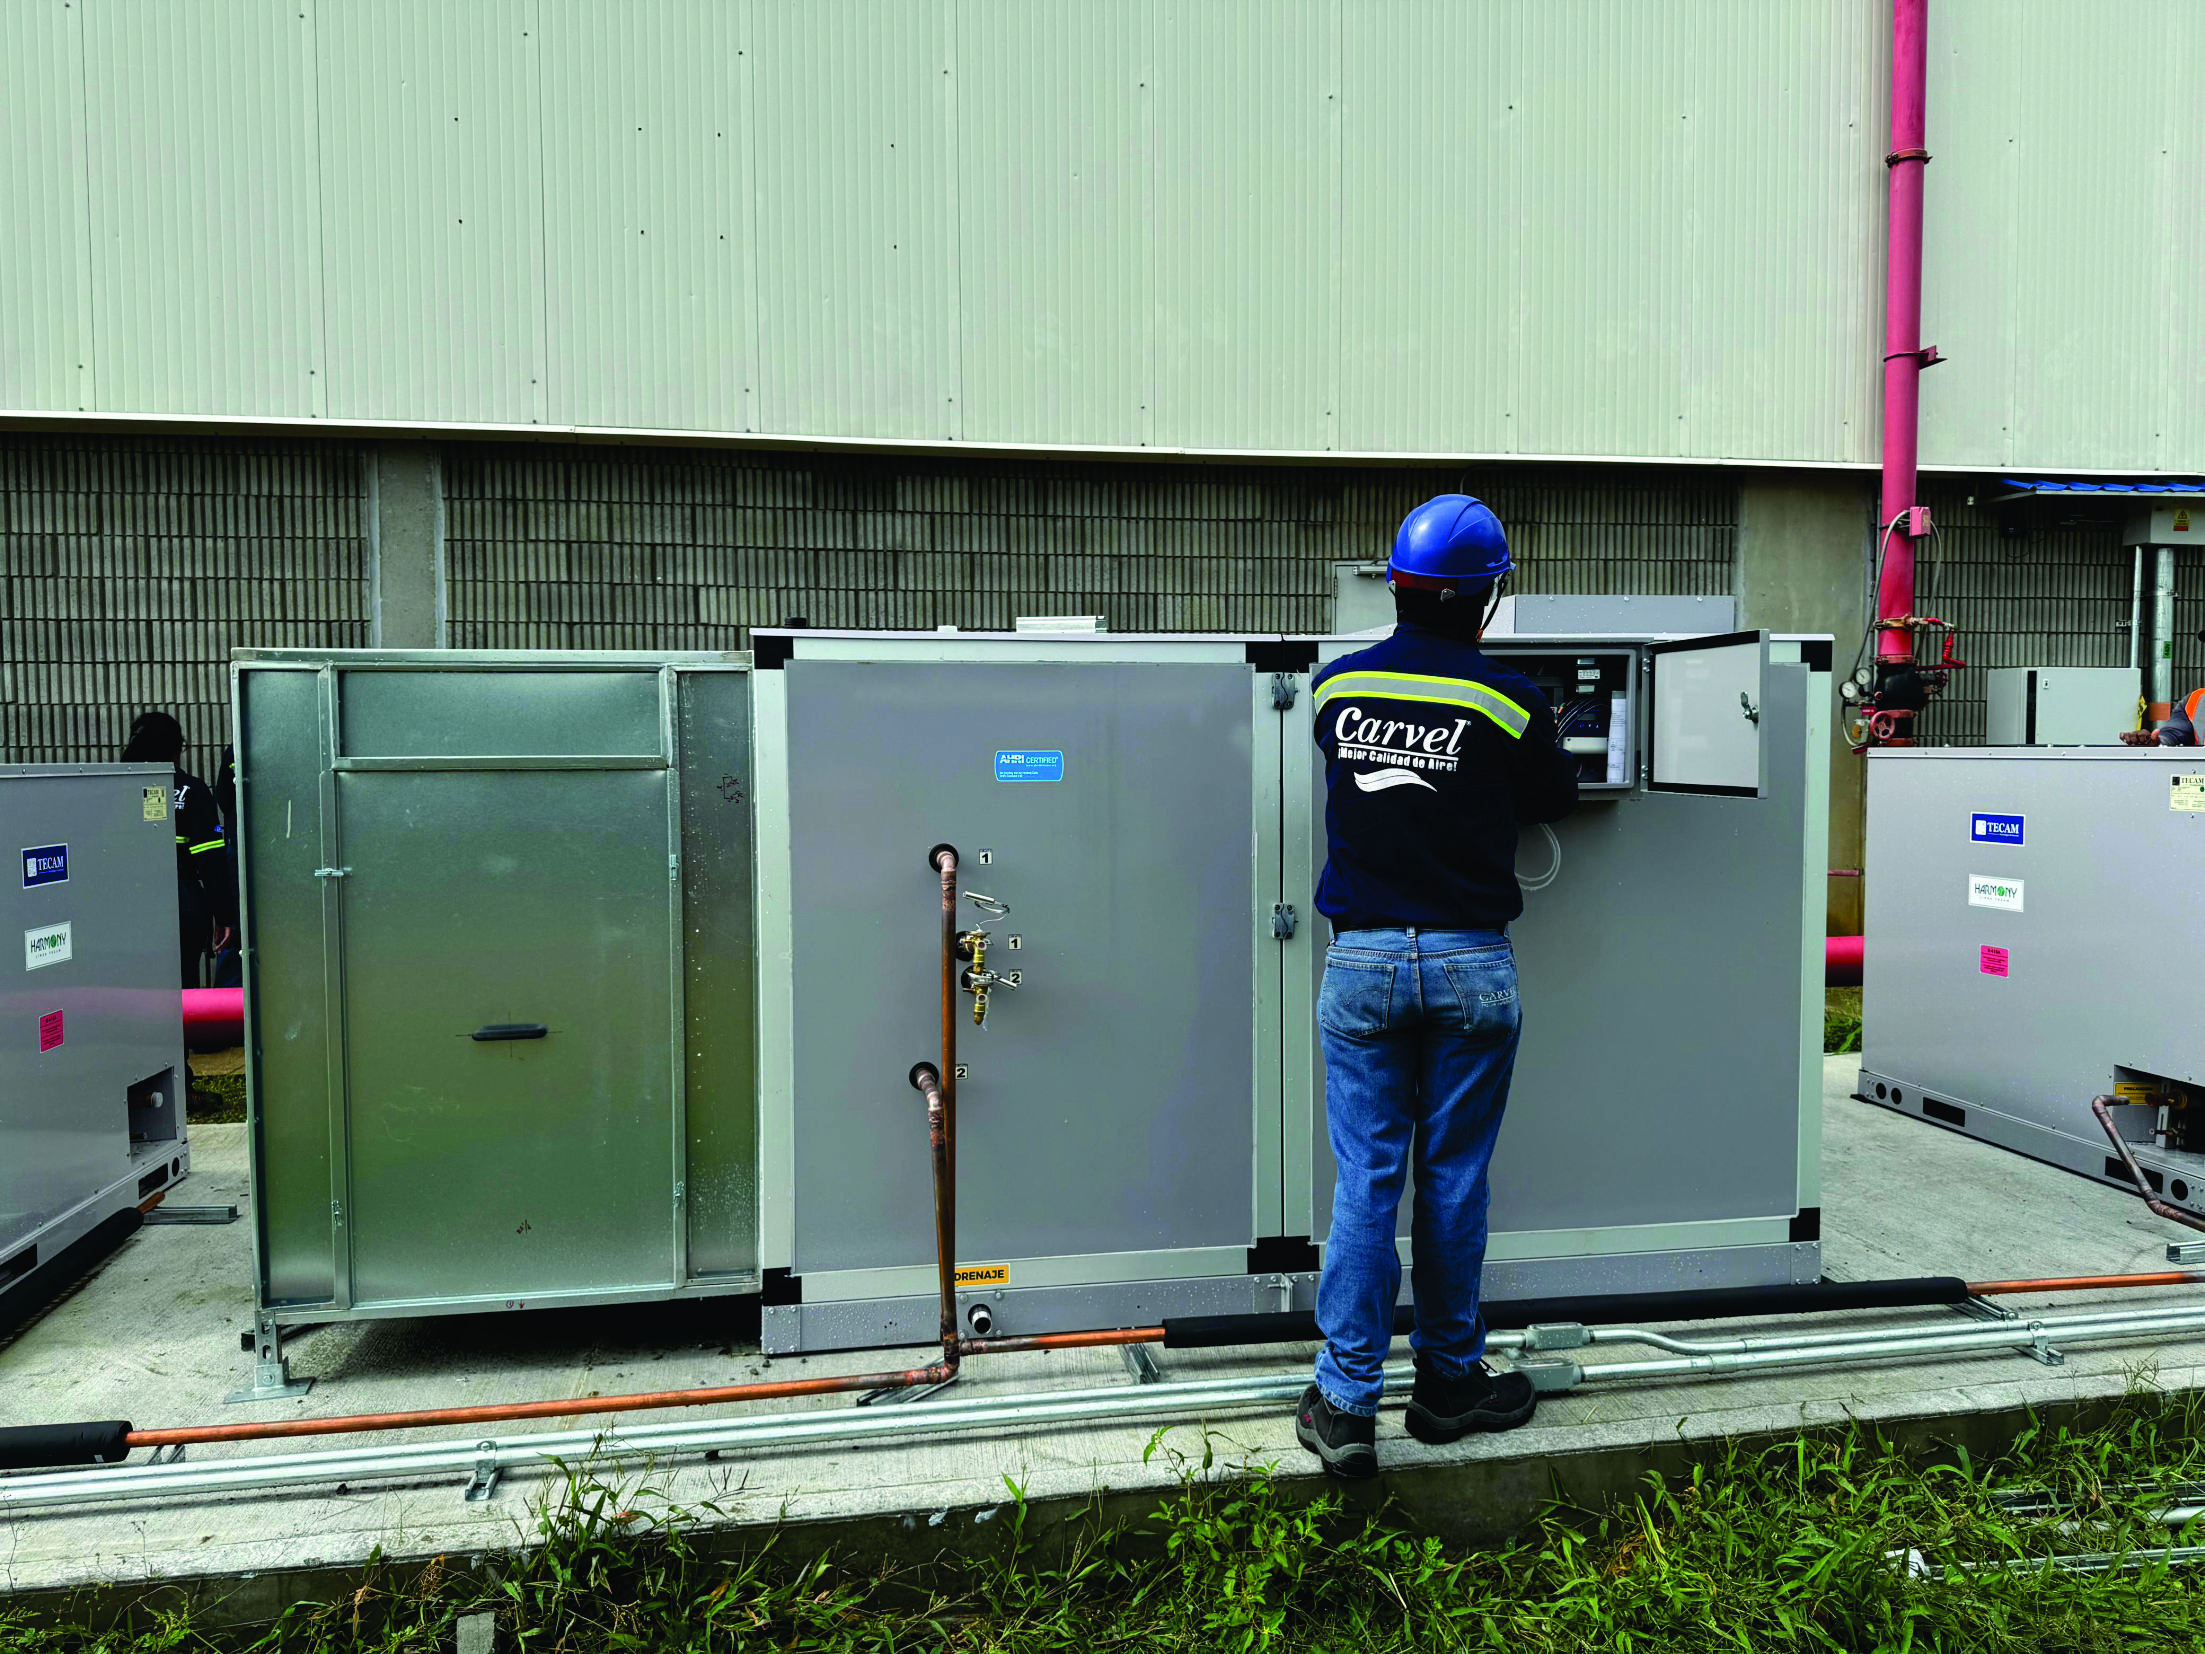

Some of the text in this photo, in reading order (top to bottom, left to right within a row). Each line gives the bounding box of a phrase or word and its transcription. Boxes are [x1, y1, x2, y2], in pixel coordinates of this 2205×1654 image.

[1335, 706, 1467, 755] Carvel
[1000, 754, 1025, 764] AHRI
[1369, 751, 1410, 767] Calidad
[1412, 756, 1425, 769] de
[1428, 759, 1458, 772] Aire!
[1987, 822, 2020, 834] TECAM
[37, 855, 64, 871] TECAM
[981, 852, 989, 864] 1
[1974, 882, 2018, 899] HARMONY
[30, 932, 67, 953] HARMONY
[1011, 938, 1018, 949] 1
[1011, 973, 1020, 983] 2
[956, 1067, 966, 1078] 2
[955, 1269, 1005, 1281] DRENAJE
